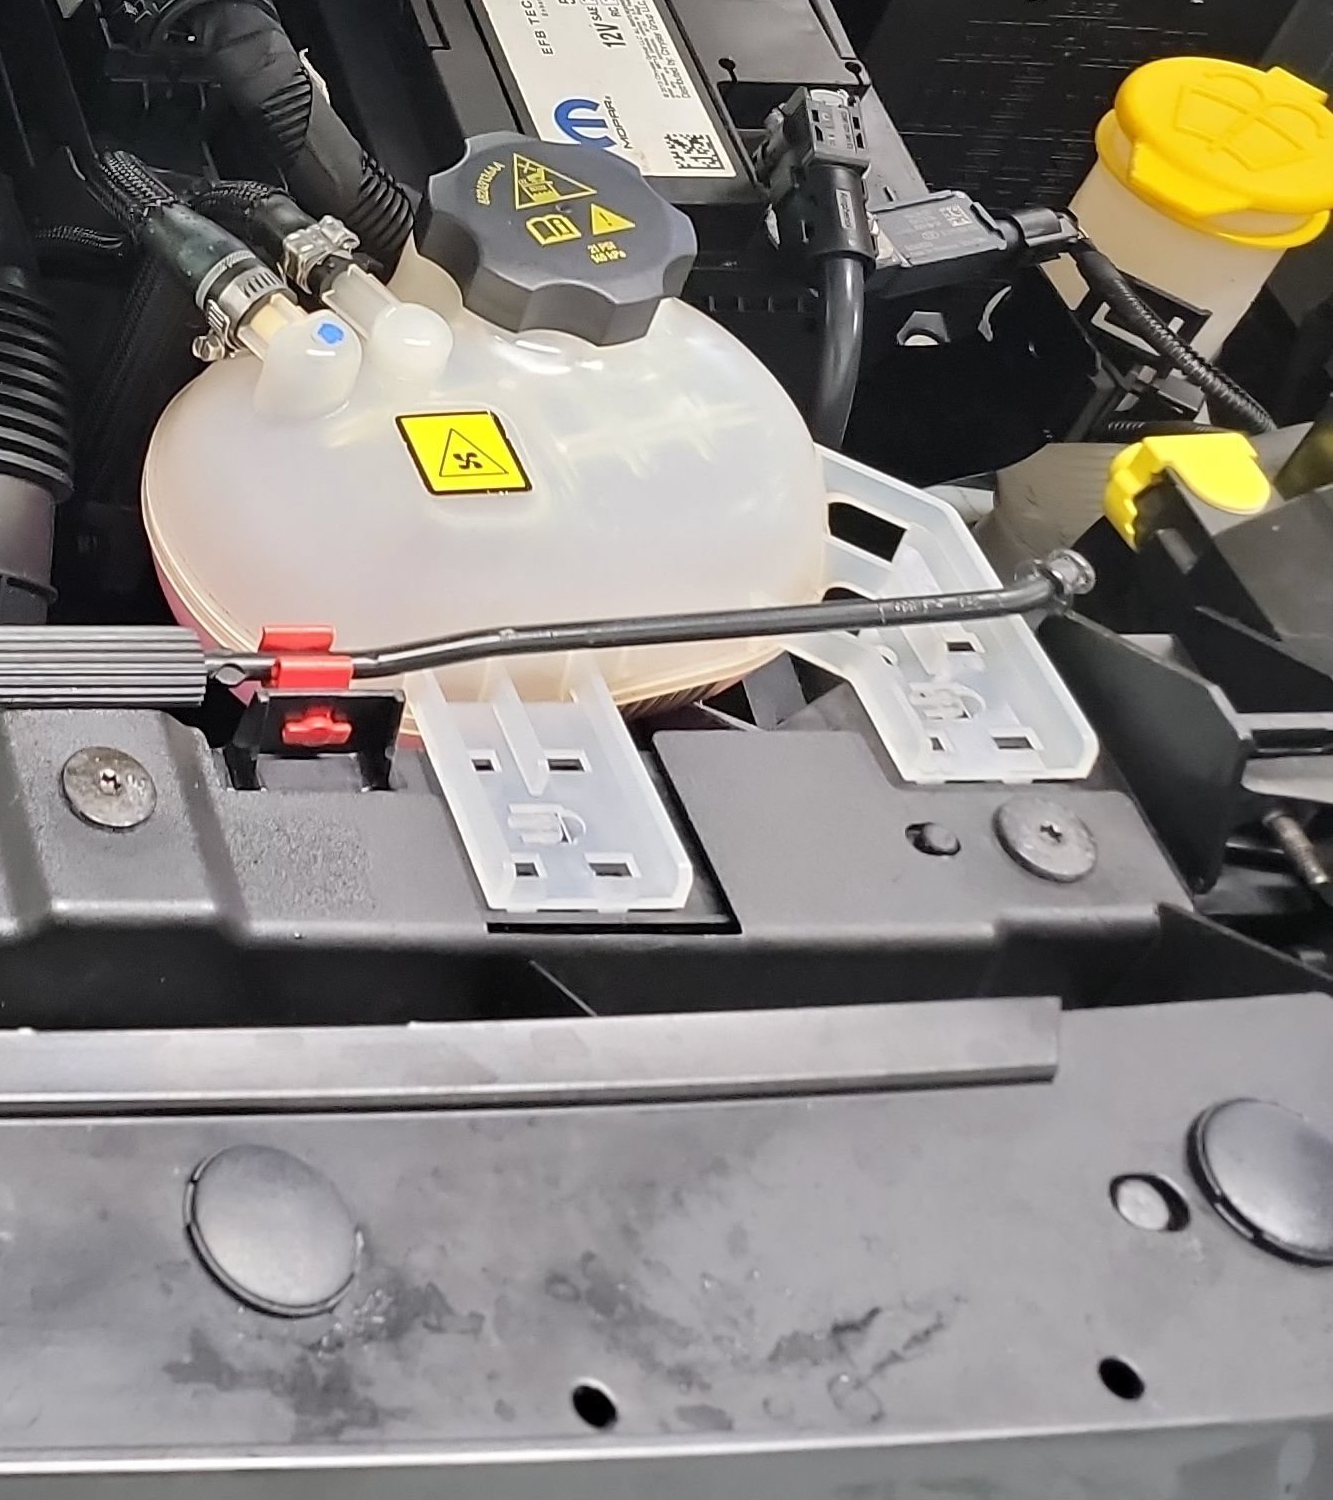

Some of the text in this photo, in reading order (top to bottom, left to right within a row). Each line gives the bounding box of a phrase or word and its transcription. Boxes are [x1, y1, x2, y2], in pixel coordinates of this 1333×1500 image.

[587, 6, 603, 22] SAE
[608, 7, 622, 18] RC
[534, 31, 554, 55] EFB
[594, 23, 627, 49] 12V
[603, 99, 634, 150] MOPAR
